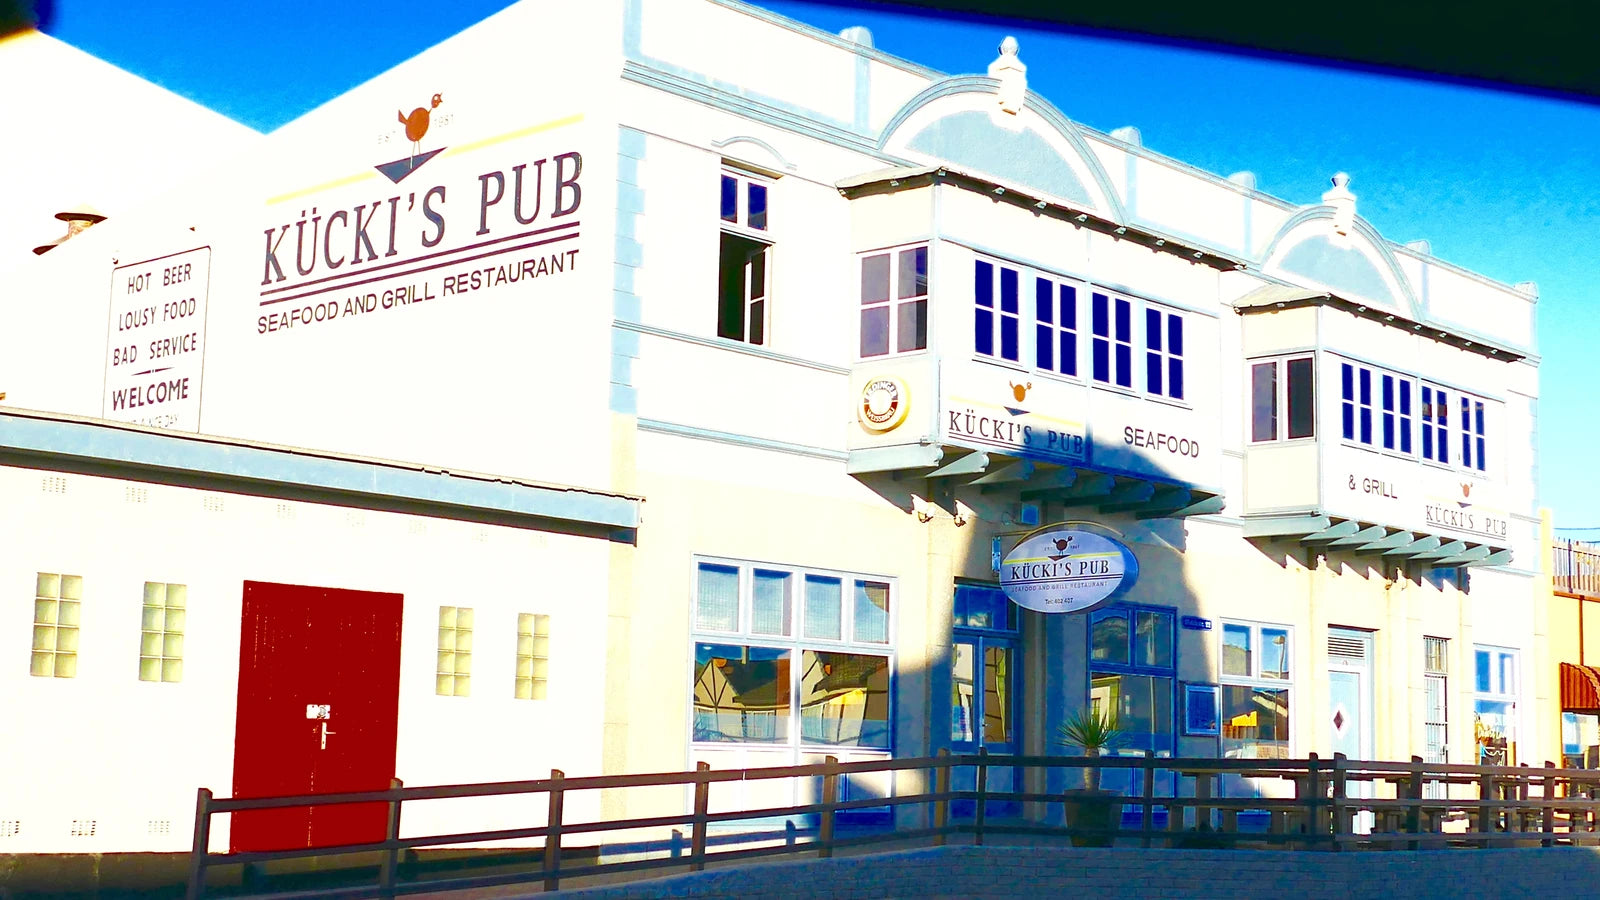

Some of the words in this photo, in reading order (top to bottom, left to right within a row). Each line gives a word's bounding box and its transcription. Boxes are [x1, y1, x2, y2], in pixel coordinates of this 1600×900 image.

[261, 185, 446, 286] KÜCKI'S
[475, 151, 583, 236] PUB
[127, 272, 152, 294] HOT
[163, 263, 192, 287] BEER
[257, 301, 338, 334] SEAFOOD
[342, 293, 377, 317] AND
[381, 282, 435, 311] GRILL
[443, 249, 580, 296] RESTAURANT
[118, 305, 157, 332] LOUSY
[163, 297, 196, 321] FOOD
[113, 345, 138, 366] BAD
[149, 332, 197, 360] SERVICE
[112, 377, 190, 411] WELCOME
[948, 408, 1033, 445] KÜCKI'S
[1046, 429, 1084, 455] PUB
[1123, 426, 1200, 458] SEAFOOD
[1348, 474, 1356, 490] &
[1362, 477, 1398, 499] GRILL
[1425, 503, 1474, 529] KÜCKI'S
[1486, 517, 1507, 536] PUB
[1011, 562, 1072, 580] KÜCKI'S
[1079, 559, 1109, 575] PUB
[1070, 581, 1108, 589] RESTAURANT
